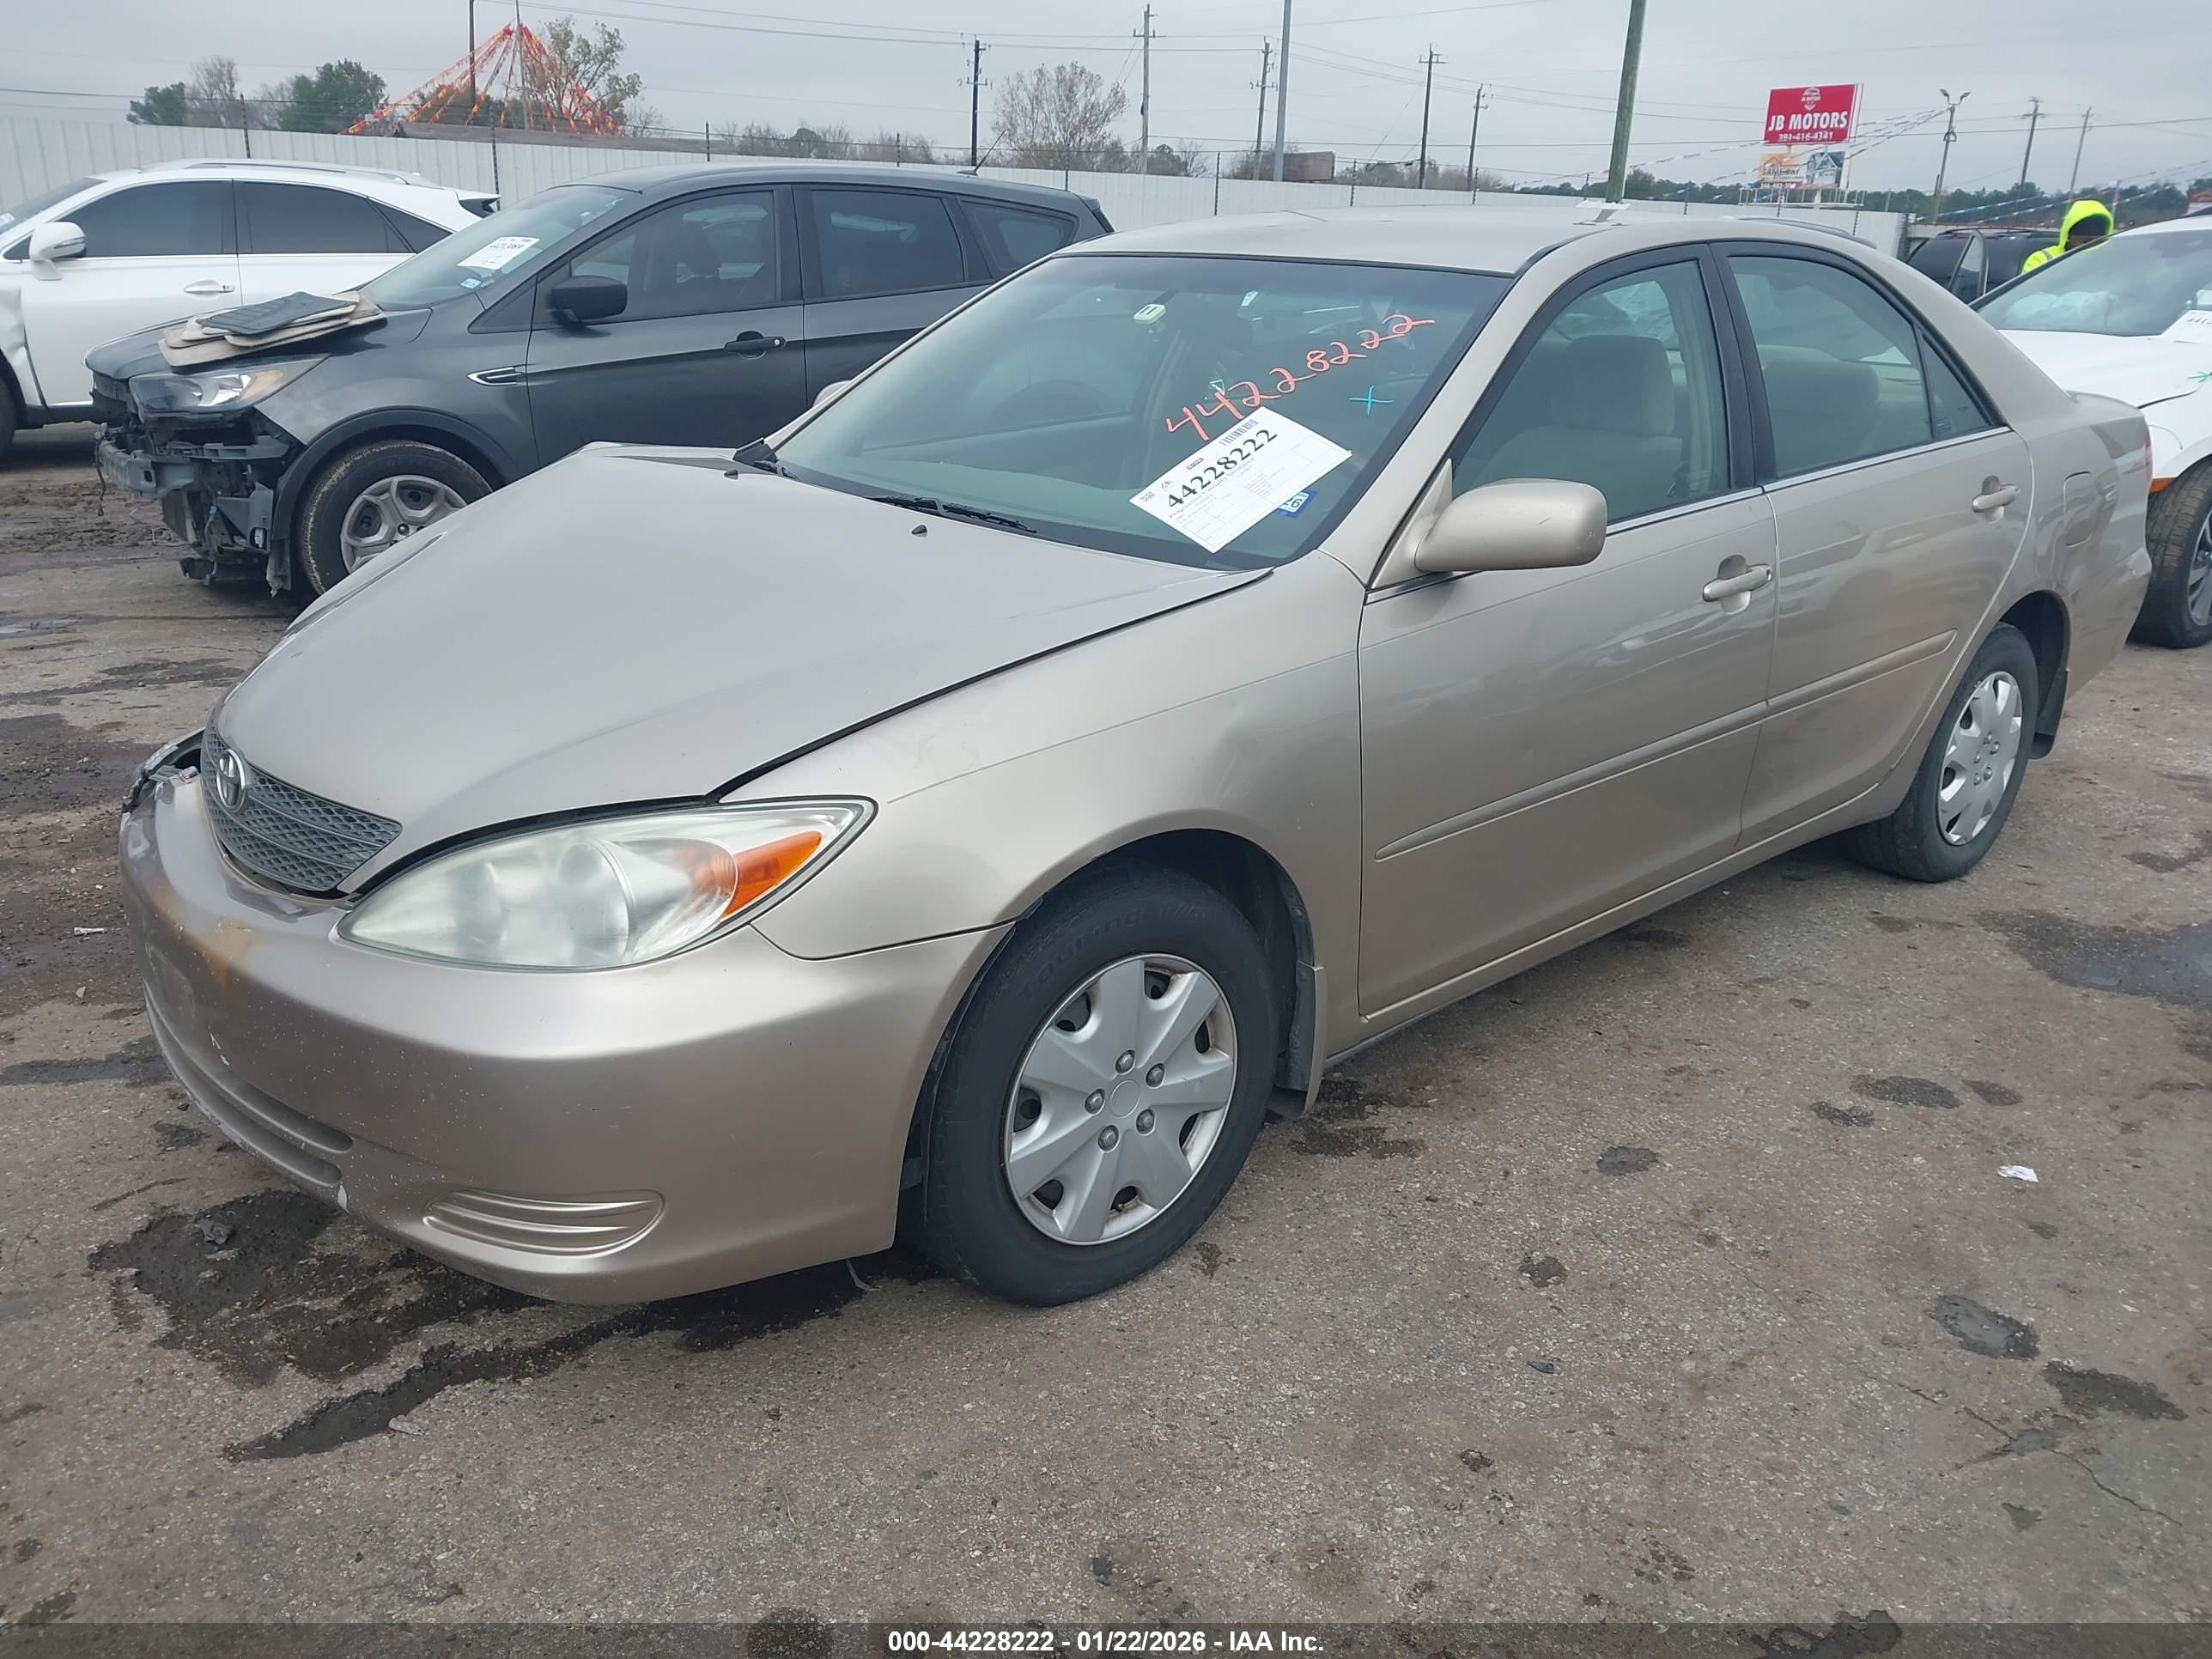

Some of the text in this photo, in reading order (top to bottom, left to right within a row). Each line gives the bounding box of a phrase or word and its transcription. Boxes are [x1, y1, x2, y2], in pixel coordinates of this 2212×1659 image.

[1769, 112, 1848, 131] JB MOTORS
[1166, 314, 1436, 441] 44228222
[1169, 429, 1278, 507] 44228222
